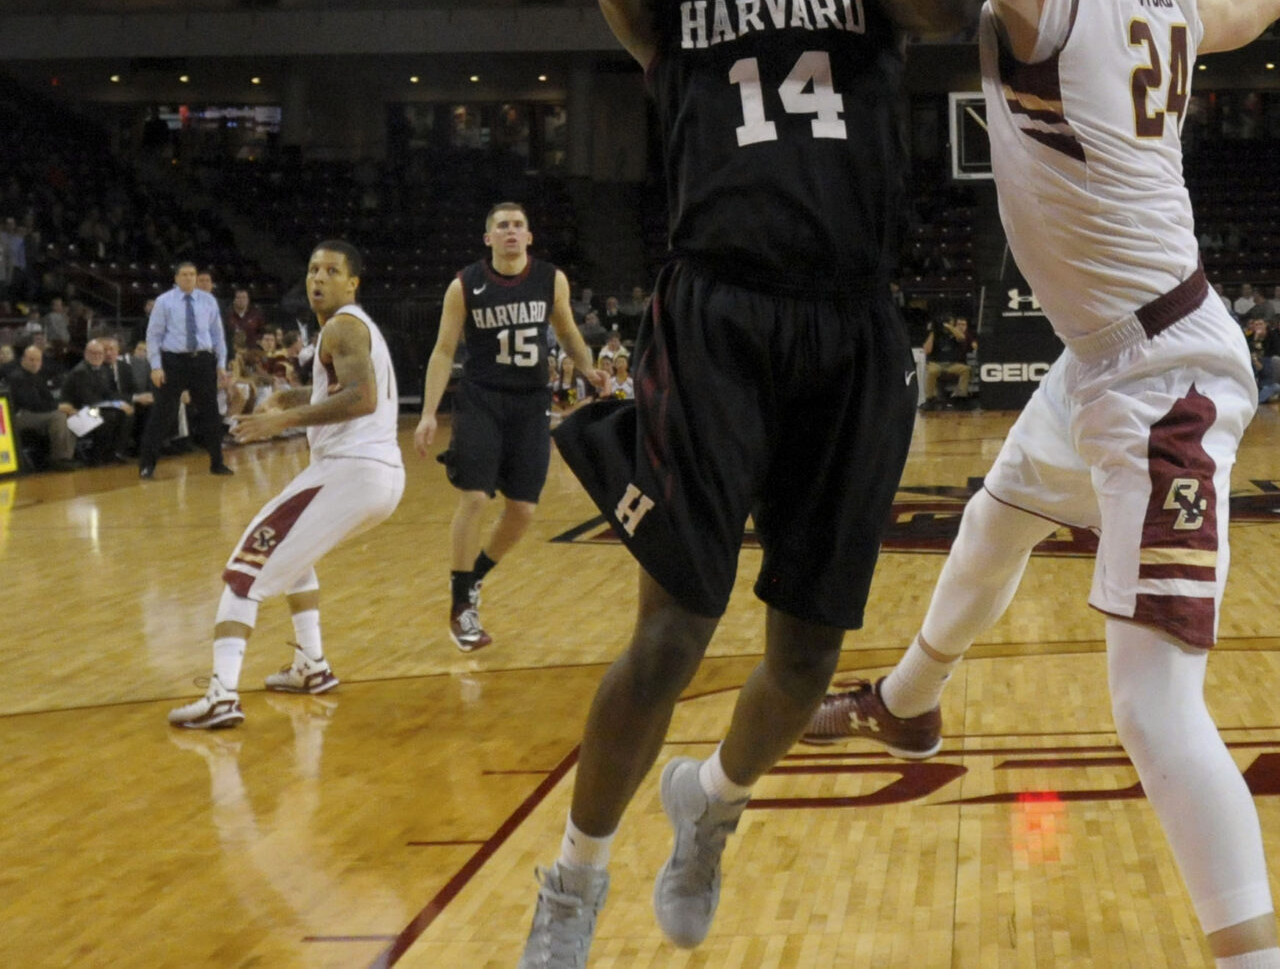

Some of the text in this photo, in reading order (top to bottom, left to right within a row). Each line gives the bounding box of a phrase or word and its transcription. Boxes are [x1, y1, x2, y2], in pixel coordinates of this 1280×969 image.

[728, 50, 848, 147] 14
[1128, 16, 1189, 139] 24
[472, 301, 547, 329] HARVARD
[496, 328, 540, 367] 15
[614, 482, 655, 538] H
